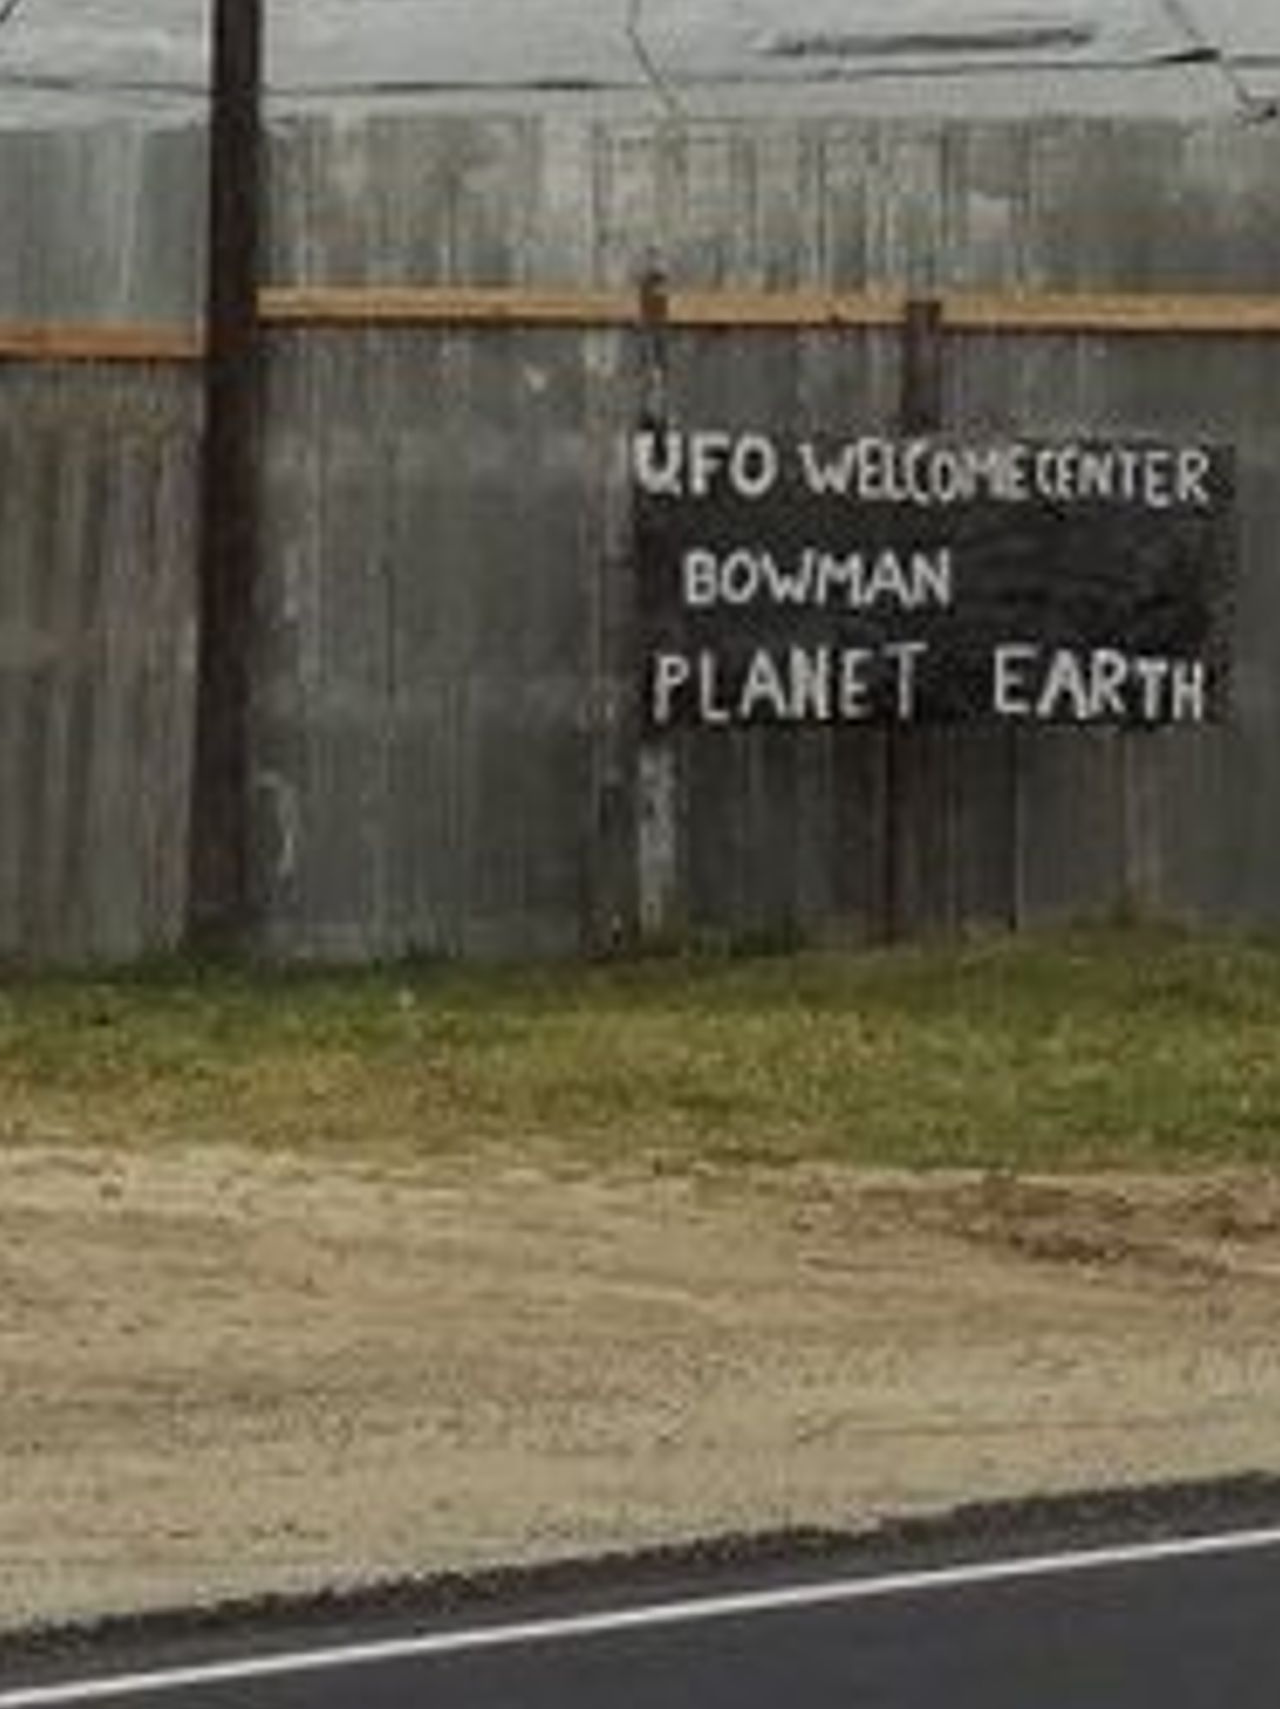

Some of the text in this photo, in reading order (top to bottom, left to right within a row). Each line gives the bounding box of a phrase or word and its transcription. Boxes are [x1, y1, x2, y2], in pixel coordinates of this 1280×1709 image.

[632, 431, 780, 497] UFO
[683, 547, 952, 607] BOWMAN
[652, 641, 1204, 724] PLANET EARTH
